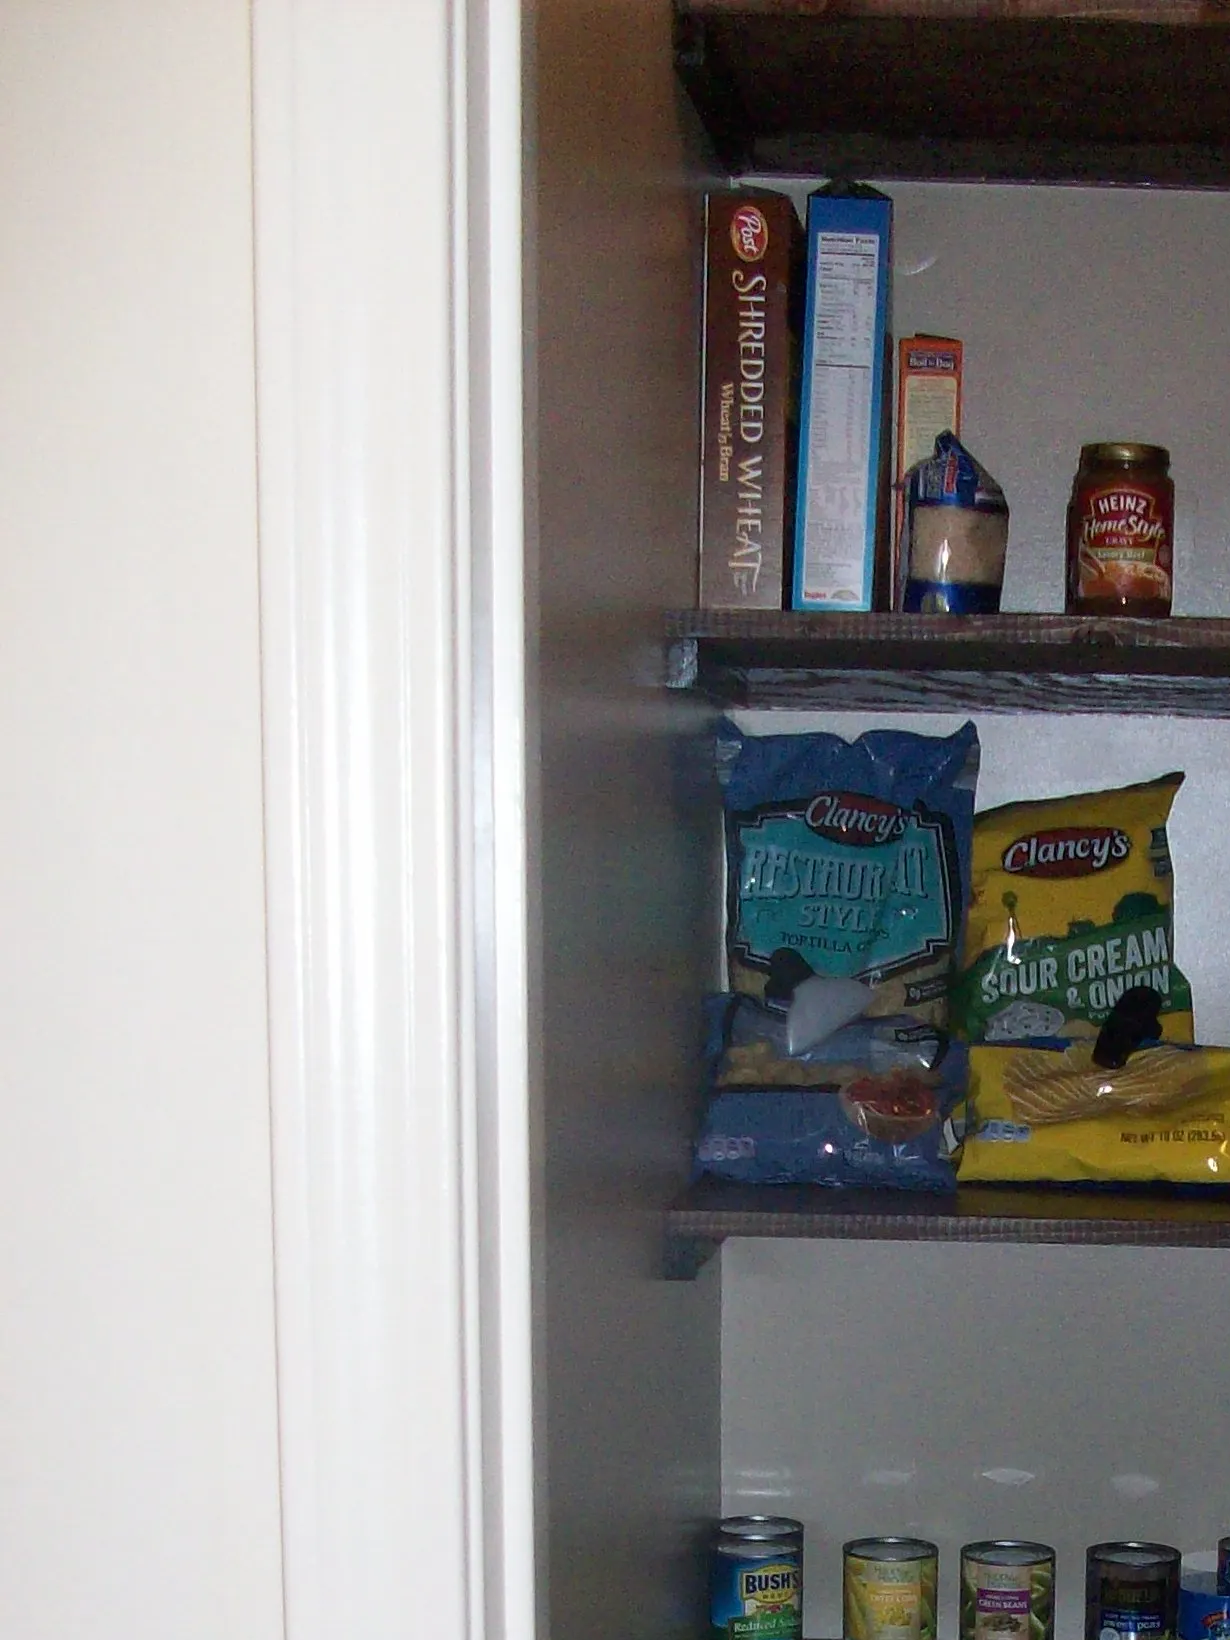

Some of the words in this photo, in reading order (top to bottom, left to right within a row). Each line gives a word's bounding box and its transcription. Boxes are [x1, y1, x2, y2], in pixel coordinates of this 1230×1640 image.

[736, 215, 762, 255] Post
[732, 269, 767, 443] SHREDDED
[720, 381, 735, 432] Wheat
[728, 455, 764, 593] WHEAT
[1098, 494, 1147, 516] HEINZ
[805, 794, 908, 844] Clancy's
[1004, 831, 1129, 873] Clancy's
[981, 957, 1059, 1004] SOUR
[1067, 927, 1169, 984] CREAM
[1066, 987, 1085, 1009] &
[1137, 1620, 1162, 1630] peas
